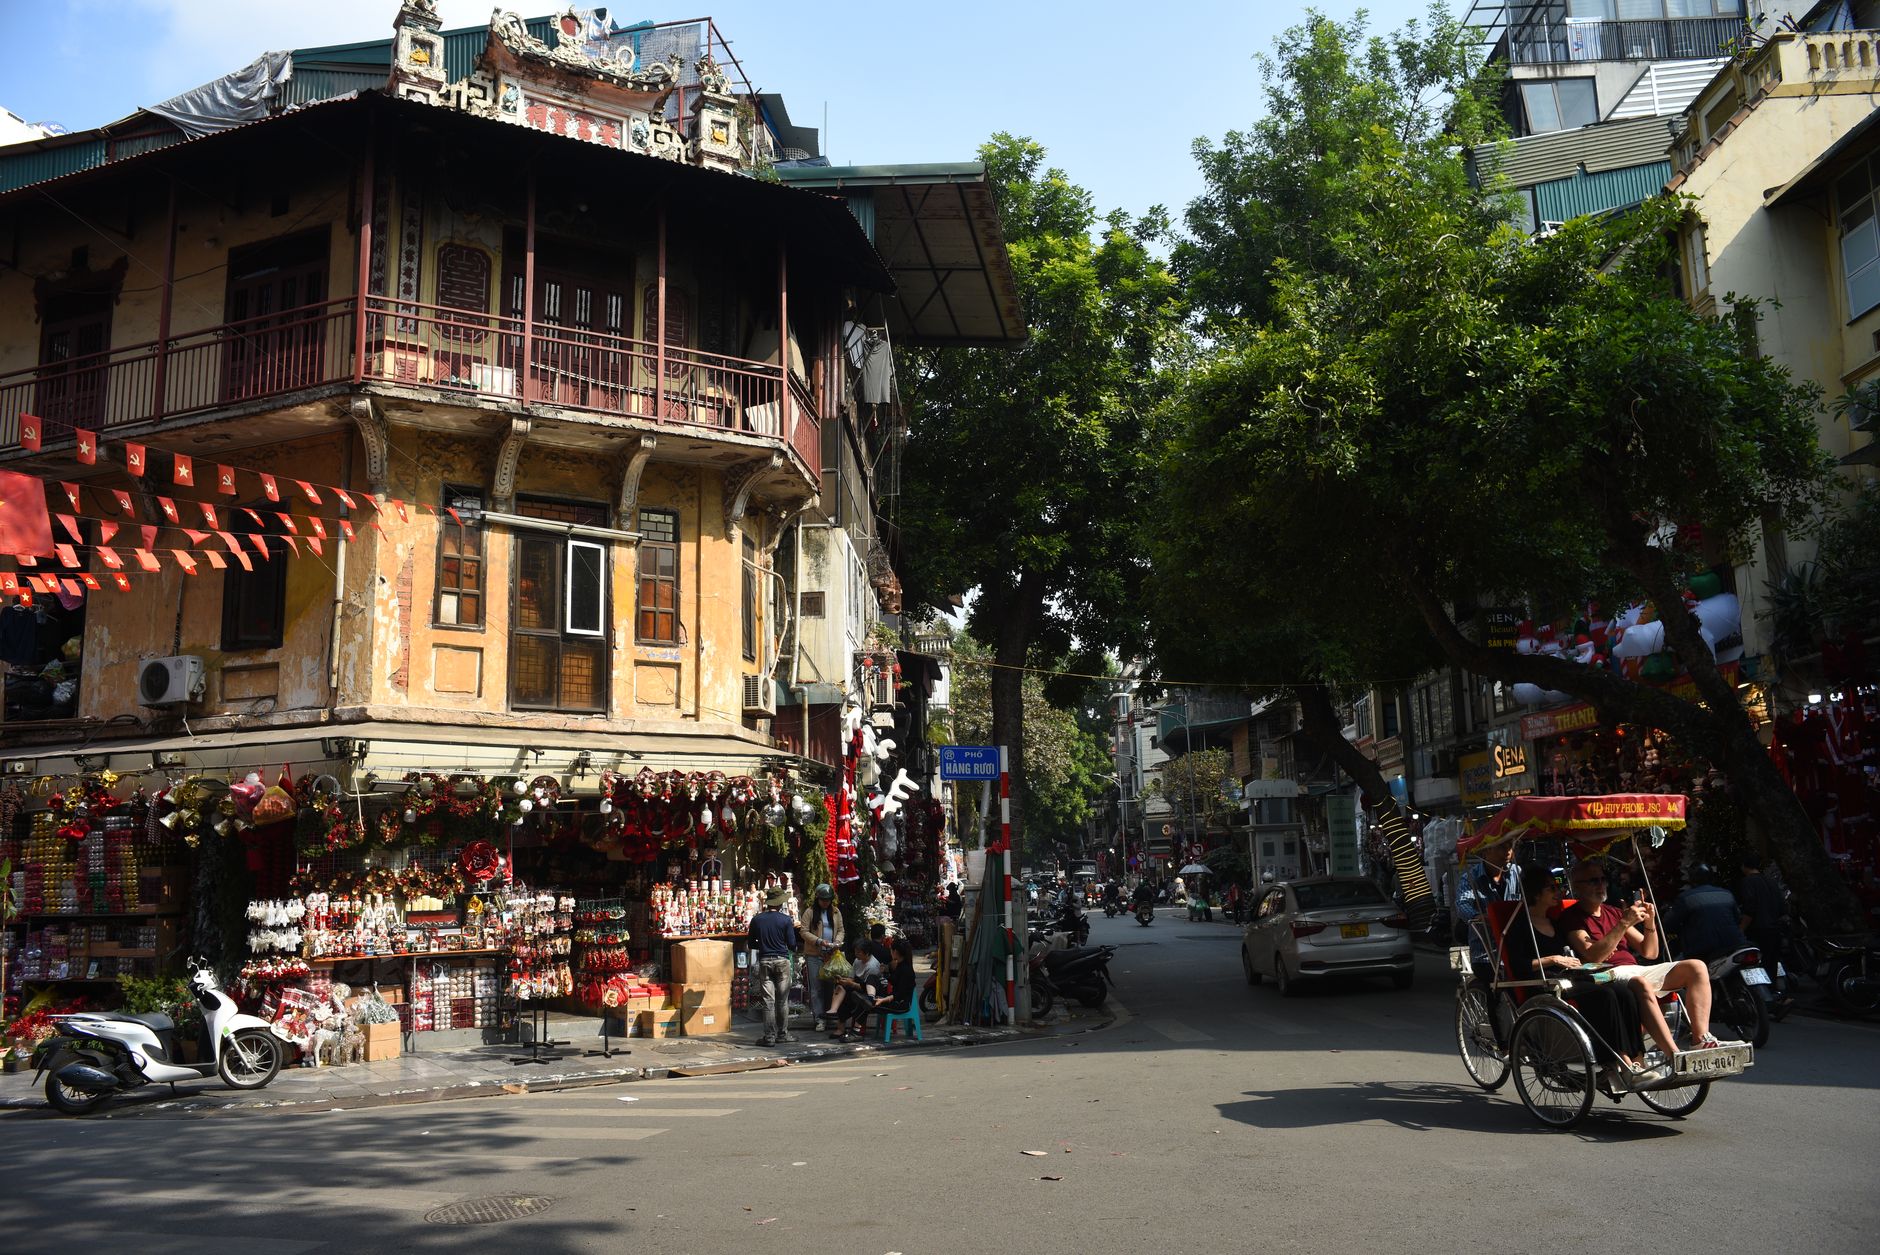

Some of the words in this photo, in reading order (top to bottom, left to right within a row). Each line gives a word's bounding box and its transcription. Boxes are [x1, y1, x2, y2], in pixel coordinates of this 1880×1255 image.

[964, 749, 983, 758] PHỐ
[945, 760, 971, 774] HÀNG
[1494, 745, 1526, 778] SIENA
[1604, 802, 1621, 813] HUY
